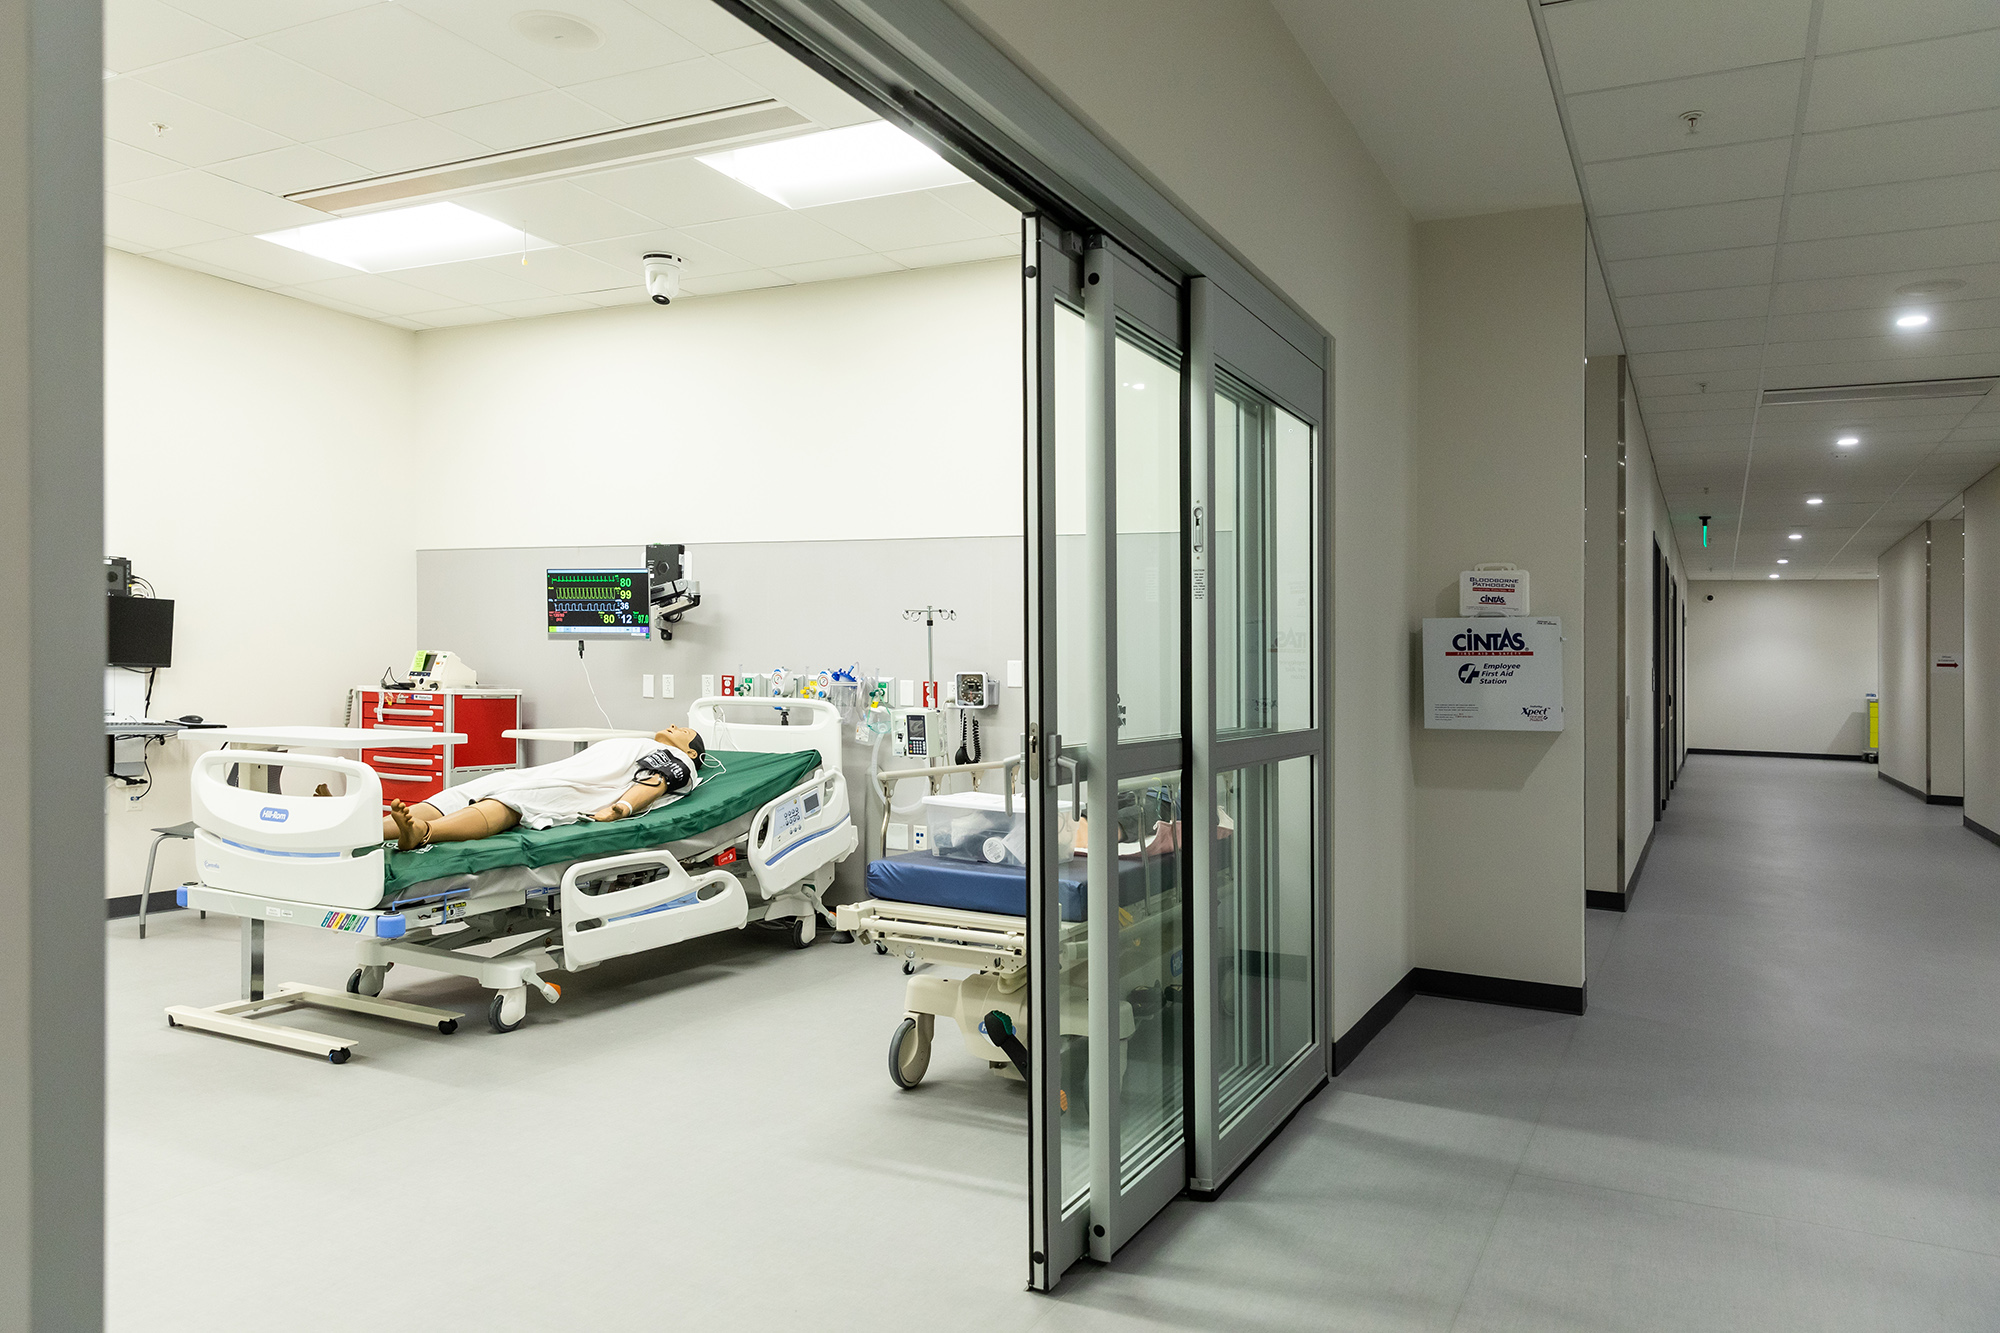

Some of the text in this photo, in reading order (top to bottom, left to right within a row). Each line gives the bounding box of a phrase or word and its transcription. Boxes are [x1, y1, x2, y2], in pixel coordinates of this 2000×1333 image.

[620, 578, 632, 588] 80
[620, 590, 632, 600] 99
[620, 602, 630, 610] 36
[603, 614, 615, 624] 80
[620, 614, 633, 624] 12
[1521, 707, 1547, 717] Xpect
